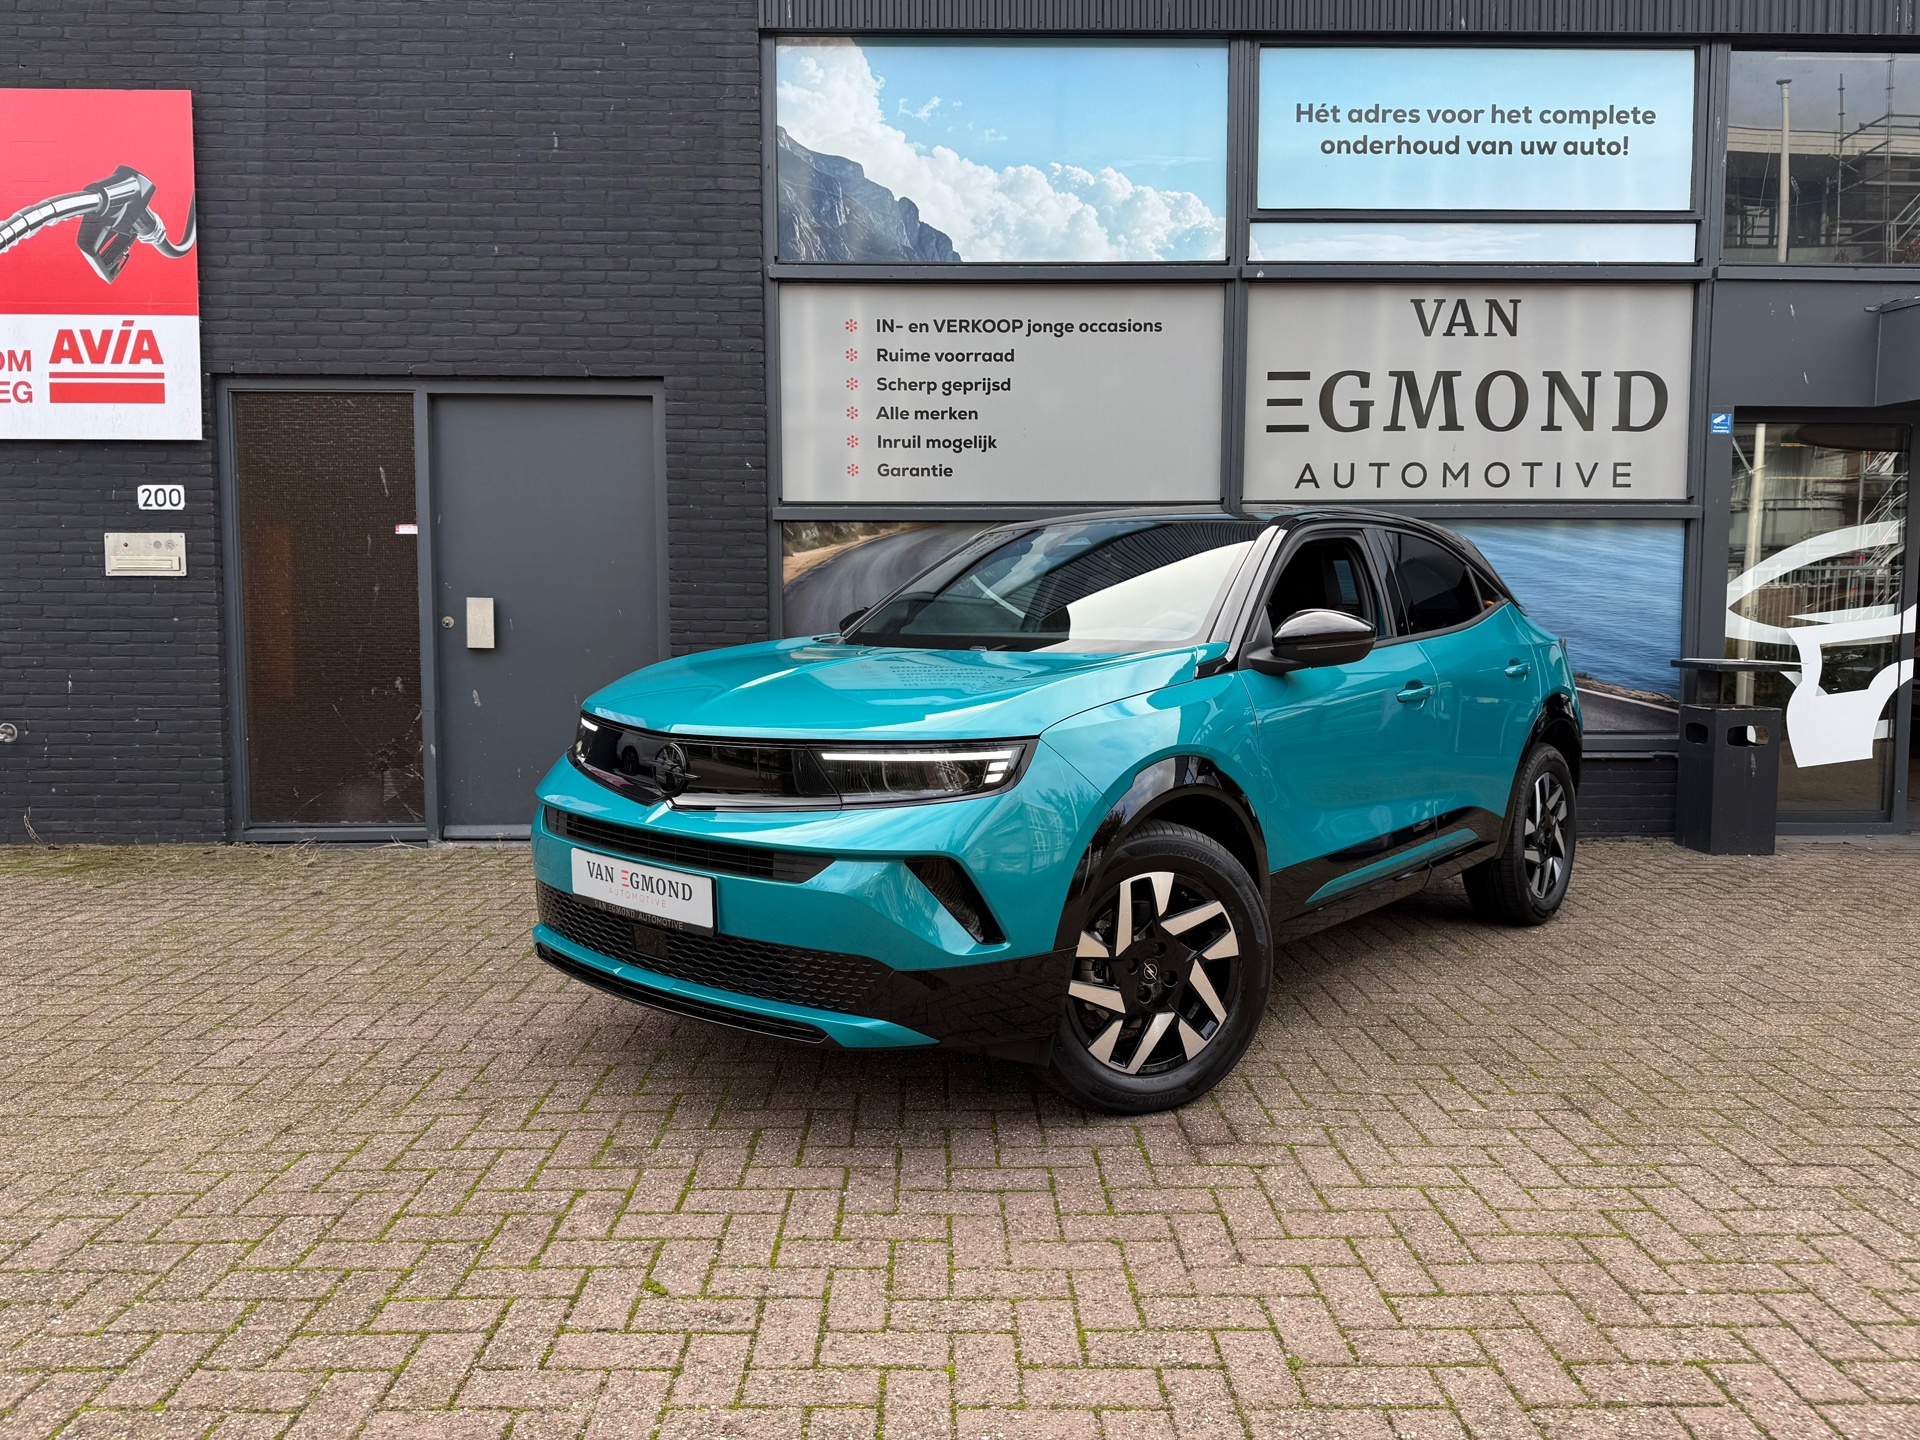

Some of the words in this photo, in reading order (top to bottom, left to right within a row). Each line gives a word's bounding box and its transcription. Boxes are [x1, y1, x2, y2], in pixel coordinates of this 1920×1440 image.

[1296, 103, 1340, 124] Hét
[1348, 104, 1421, 124] adres
[1427, 109, 1485, 124] voor
[1491, 104, 1533, 125] het
[1540, 104, 1657, 131] complete
[1320, 135, 1459, 156] onderhoud
[1467, 140, 1513, 156] van
[1521, 140, 1558, 156] uw
[1563, 135, 1629, 156] auto!
[876, 318, 904, 333] IN-
[908, 322, 930, 333] en
[932, 318, 1025, 334] VERKOOP
[1026, 318, 1075, 338] jonge
[1079, 318, 1163, 333] occasions
[1410, 298, 1522, 337] VAN
[0, 349, 32, 372] M
[876, 347, 931, 363] Ruime
[934, 348, 1015, 363] voorraad
[876, 376, 938, 396] Scherp
[941, 377, 1011, 397] geprijsd
[1266, 369, 1669, 434] EGMOND
[876, 405, 910, 421] Alle
[914, 406, 979, 421] merken
[877, 434, 921, 449] Inruil
[925, 434, 998, 454] mogelijk
[876, 462, 954, 478] Garantie
[1294, 461, 1632, 490] AUTOMOTIVE
[141, 487, 182, 508] 200
[586, 860, 614, 884] VAN
[621, 869, 693, 901] EGMOND
[608, 887, 667, 909] AUTOMOTIVE
[594, 899, 607, 911] VAN
[607, 904, 636, 919] EGMOND
[638, 912, 684, 931] AUTOMOTIVE
